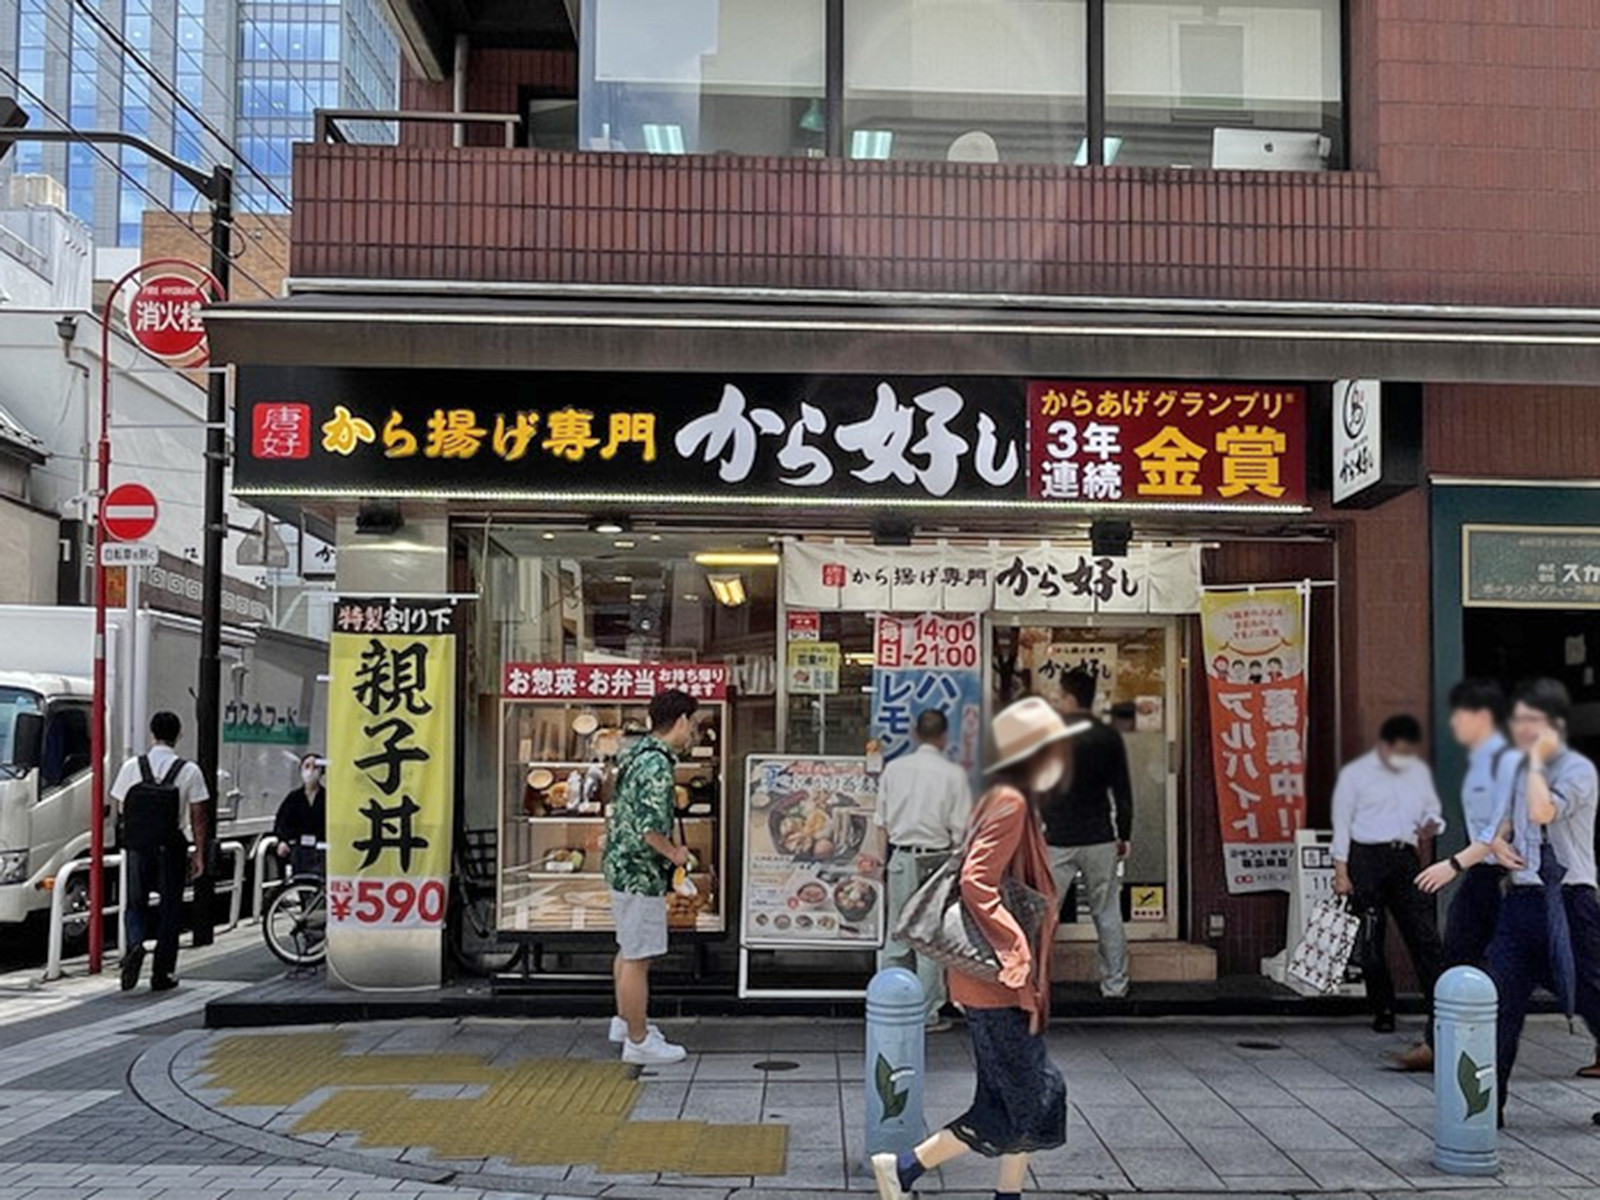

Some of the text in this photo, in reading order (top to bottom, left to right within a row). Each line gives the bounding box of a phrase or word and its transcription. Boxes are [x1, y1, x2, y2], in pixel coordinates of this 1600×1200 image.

[136, 301, 205, 332] 消火栓
[322, 406, 656, 462] から揚げ専門
[675, 382, 1018, 497] から好し
[1047, 421, 1121, 459] 3年
[1041, 461, 1122, 499] 連続
[1134, 425, 1286, 498] 金賞
[852, 566, 987, 587] から揚げ専門
[996, 556, 1138, 602] から好し
[338, 606, 453, 633] 特製割り下
[914, 618, 976, 645] 14:00
[352, 638, 433, 873] 親子丼
